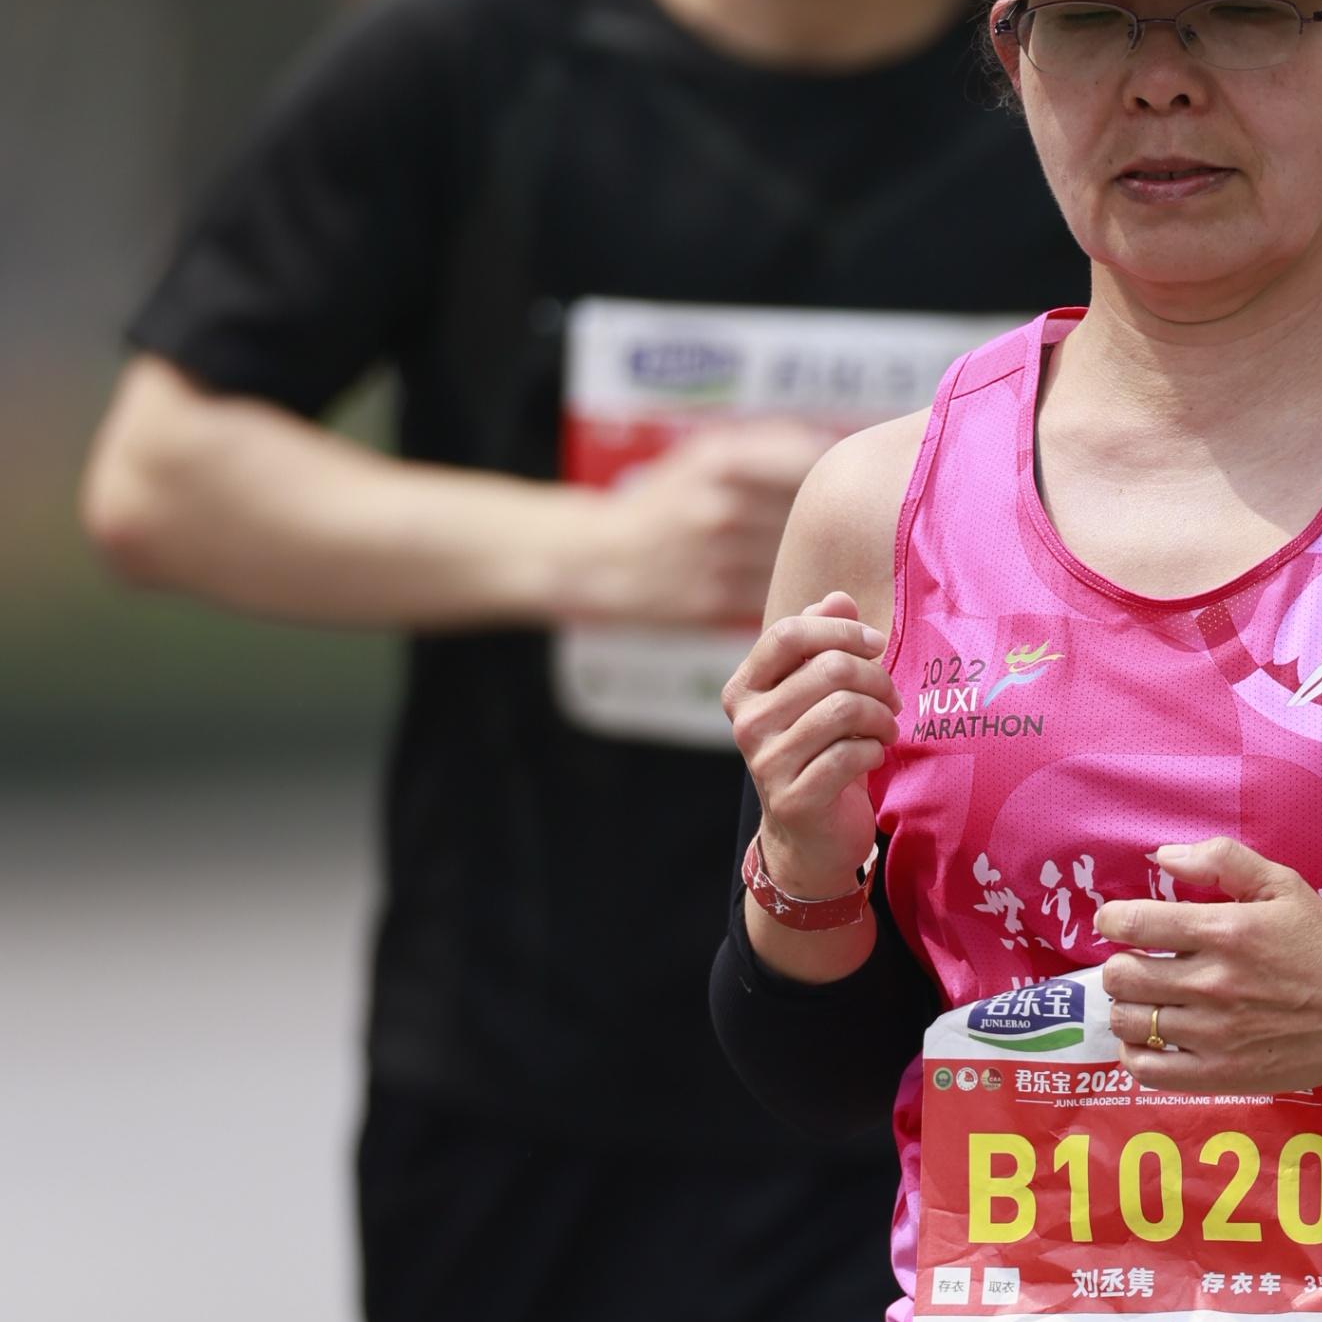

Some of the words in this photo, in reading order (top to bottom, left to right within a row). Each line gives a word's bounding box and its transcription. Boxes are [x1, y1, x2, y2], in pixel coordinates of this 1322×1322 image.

[918, 687, 979, 718] WUXI
[911, 715, 1044, 744] MARATHON
[980, 1018, 1031, 1029] JUNLEBAO
[1015, 1069, 1072, 1094] 君乐宝
[1075, 1069, 1133, 1093] 2023
[1214, 1095, 1274, 1105] MARATHON
[938, 1279, 965, 1293] 存衣
[988, 1280, 1014, 1293] 取衣
[1201, 1272, 1281, 1295] 存衣车
